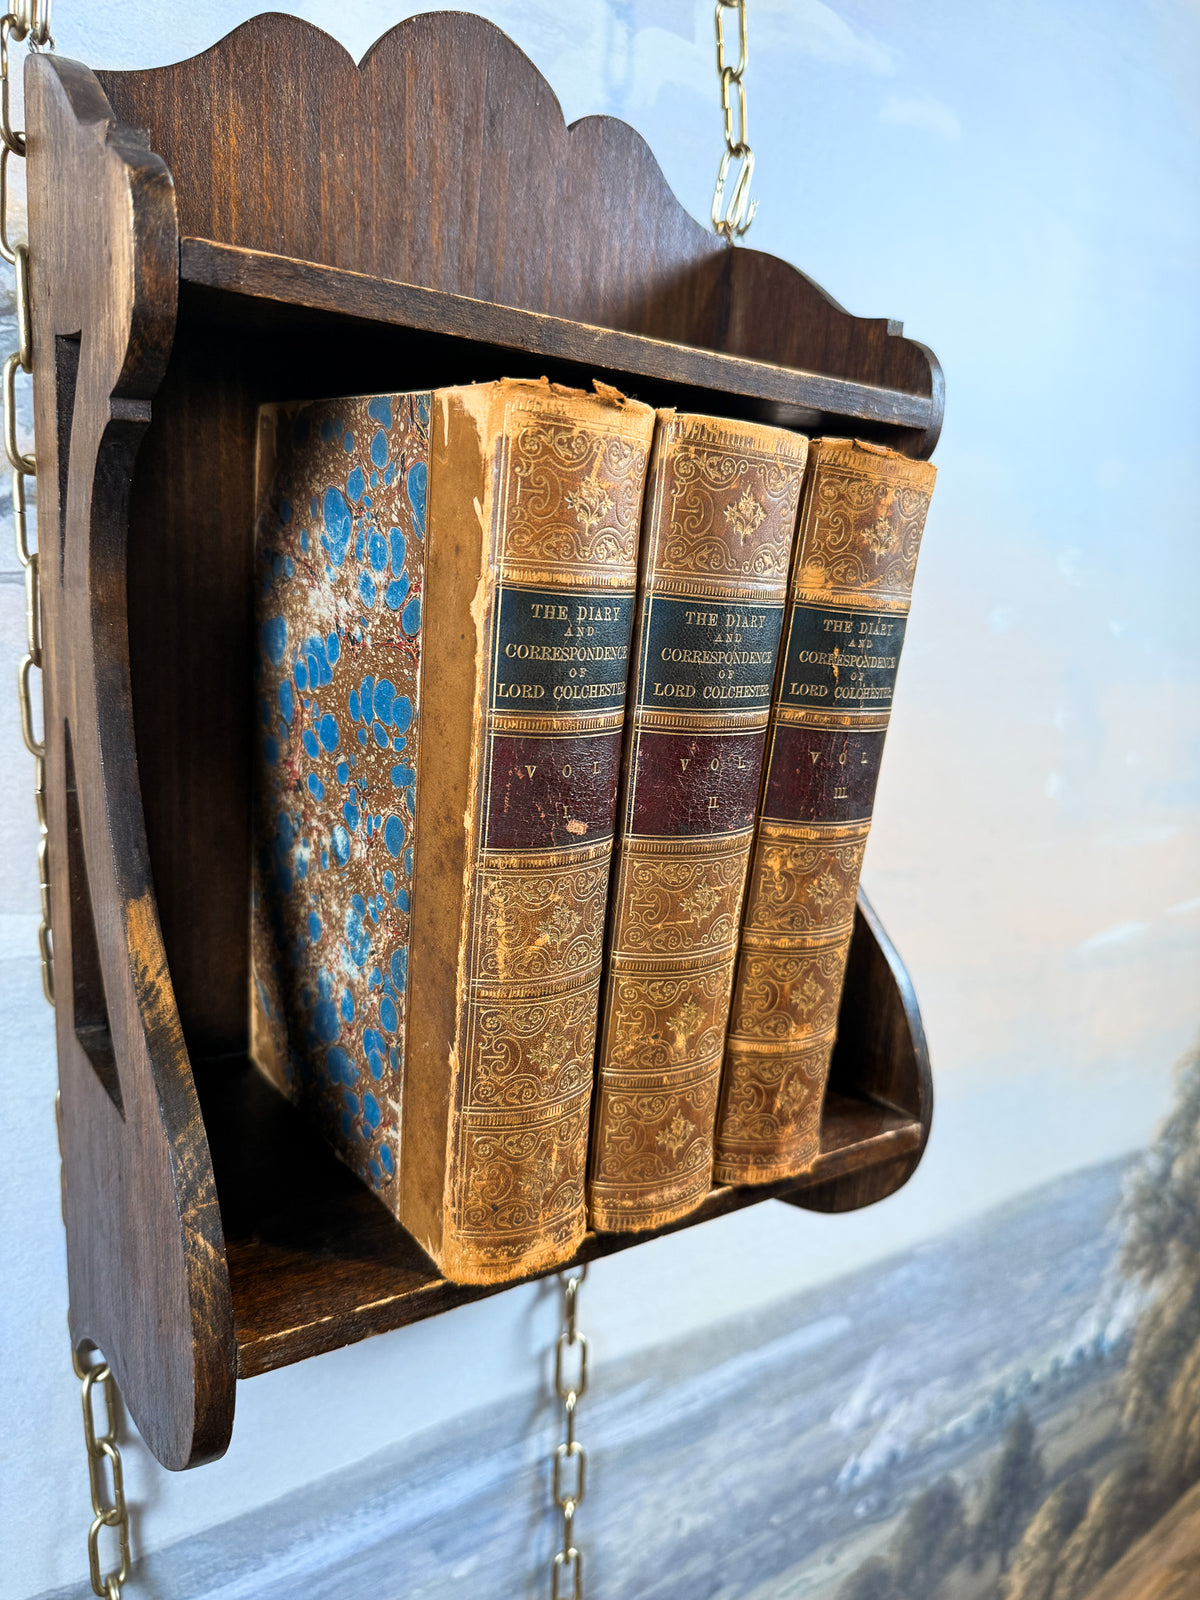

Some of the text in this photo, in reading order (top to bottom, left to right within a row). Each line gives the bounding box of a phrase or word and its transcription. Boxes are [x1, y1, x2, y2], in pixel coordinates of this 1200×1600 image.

[531, 604, 621, 621] THE DIARY
[685, 611, 766, 628] THE DIARY
[564, 626, 594, 637] AND
[823, 619, 893, 636] THE DIARY
[715, 633, 742, 643] AND
[848, 638, 873, 649] AND
[505, 643, 628, 661] CORRESPONDENCE
[661, 648, 772, 664] CORRESPONDENCE
[569, 667, 587, 678] OF
[718, 670, 734, 679] OF
[850, 672, 864, 681] OF
[497, 683, 545, 698] LORD
[653, 683, 696, 698] LORD
[789, 683, 828, 697] LORD
[833, 786, 848, 799] III
[708, 796, 719, 809] II
